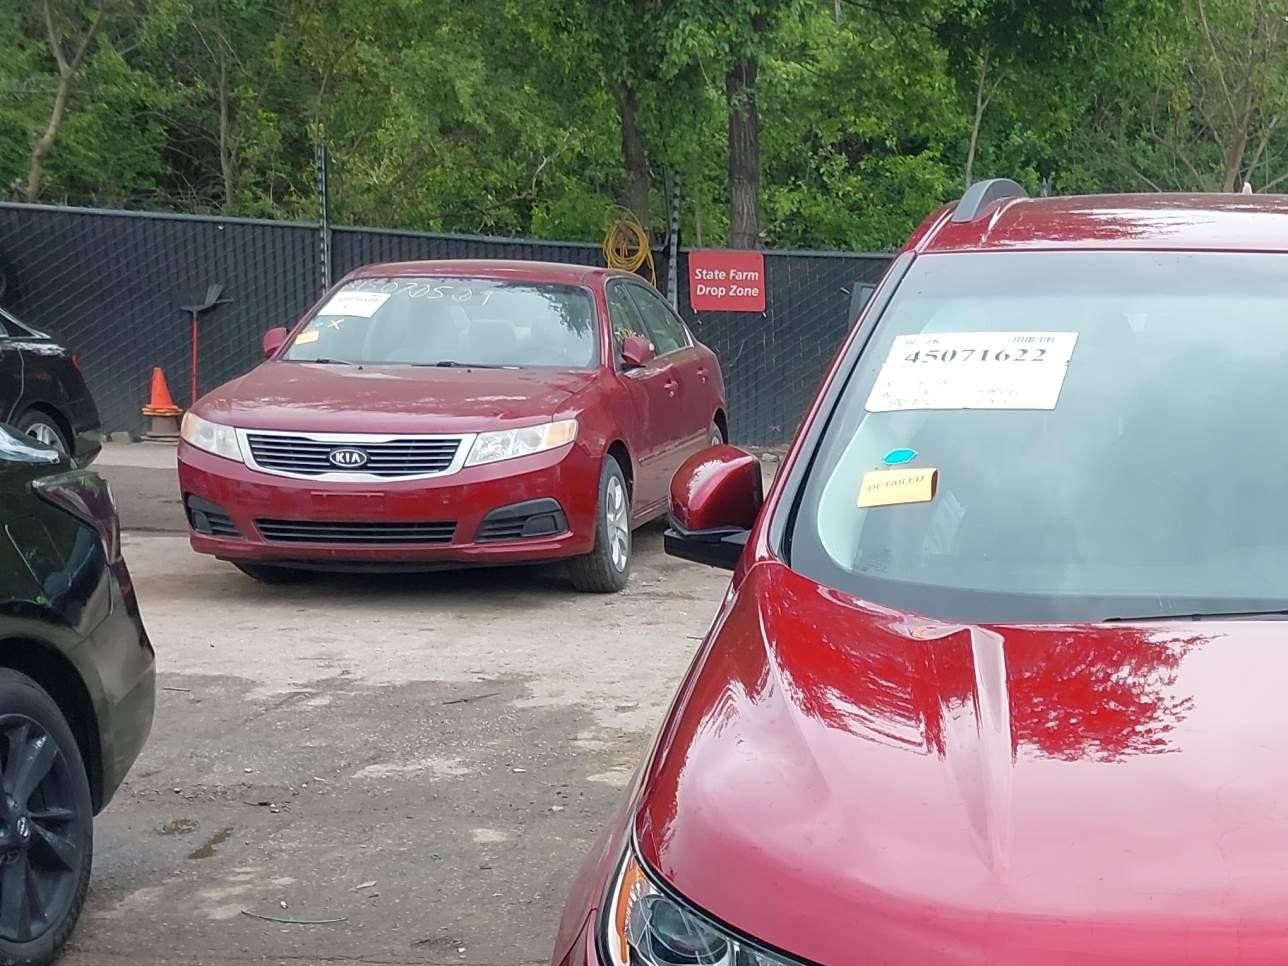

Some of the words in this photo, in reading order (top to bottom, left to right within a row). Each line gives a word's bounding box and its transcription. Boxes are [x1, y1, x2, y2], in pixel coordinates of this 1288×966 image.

[695, 268, 726, 280] State
[729, 269, 759, 280] Farm
[696, 285, 726, 298] Drop
[728, 285, 759, 296] Zone
[903, 348, 1048, 363] 45071622
[335, 452, 361, 463] KIA
